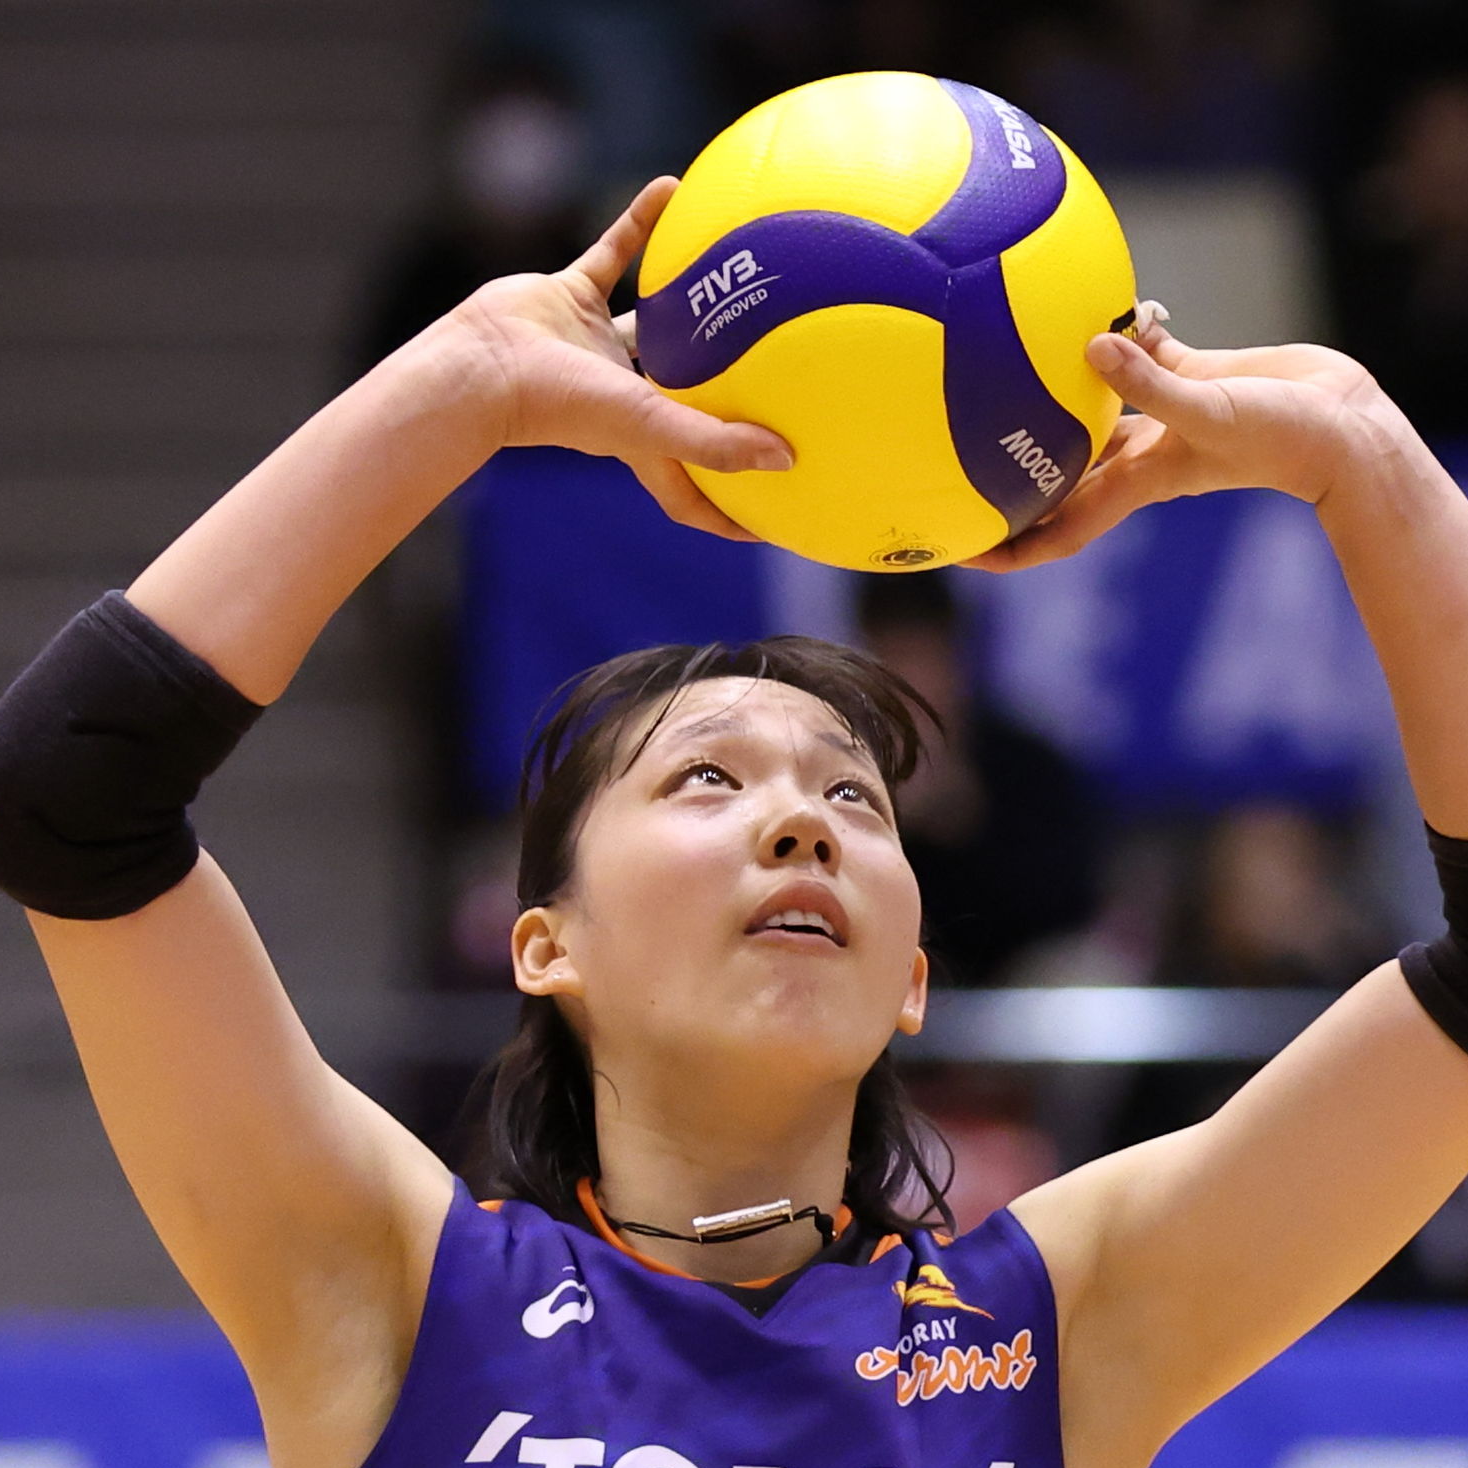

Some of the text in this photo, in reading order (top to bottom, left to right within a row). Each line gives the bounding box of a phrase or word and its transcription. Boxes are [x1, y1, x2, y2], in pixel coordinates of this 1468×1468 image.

[703, 287, 769, 342] APPROVED
[997, 427, 1066, 498] V200W
[897, 1315, 958, 1355] ORAY
